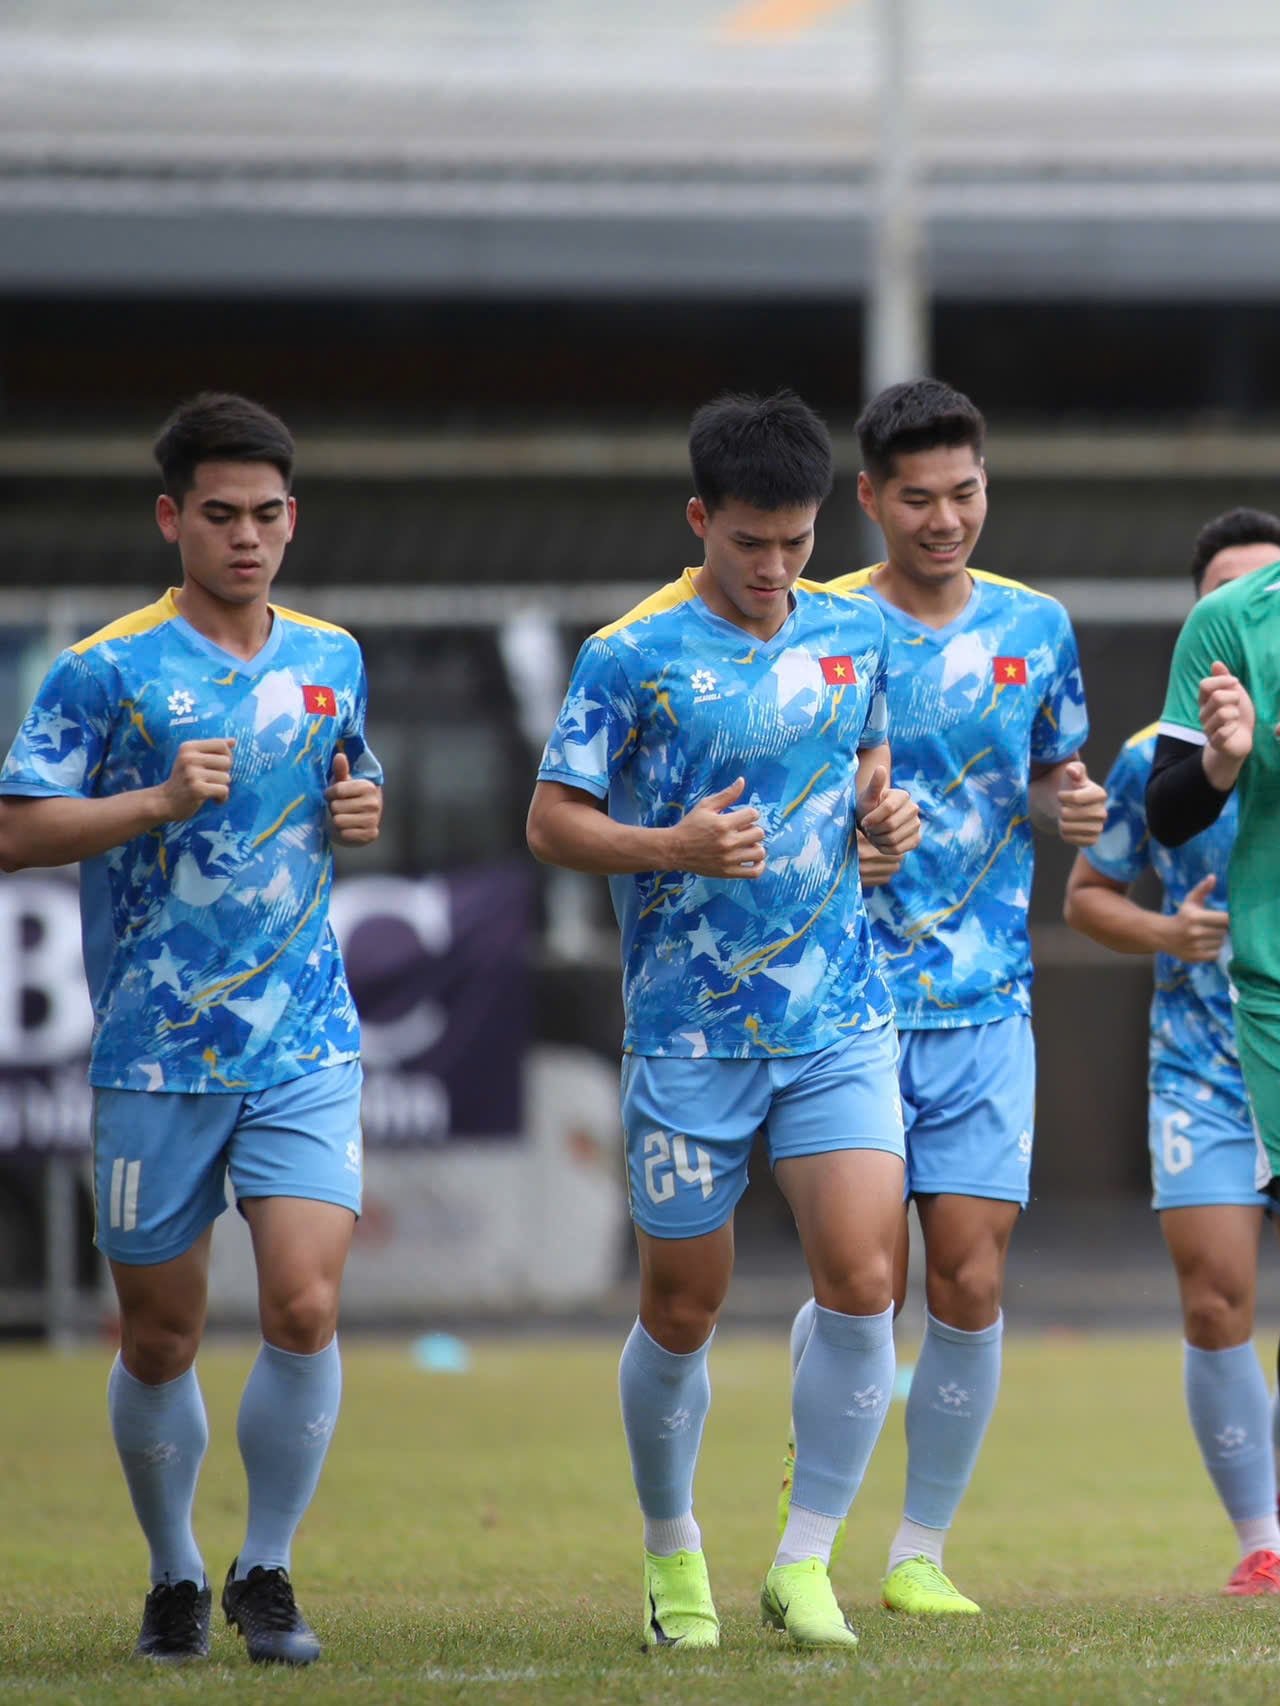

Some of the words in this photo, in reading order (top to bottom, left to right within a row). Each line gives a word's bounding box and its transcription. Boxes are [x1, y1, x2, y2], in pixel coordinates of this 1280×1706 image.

[643, 1129, 713, 1205] 24
[1162, 1110, 1193, 1176] 6
[110, 1157, 141, 1232] 11
